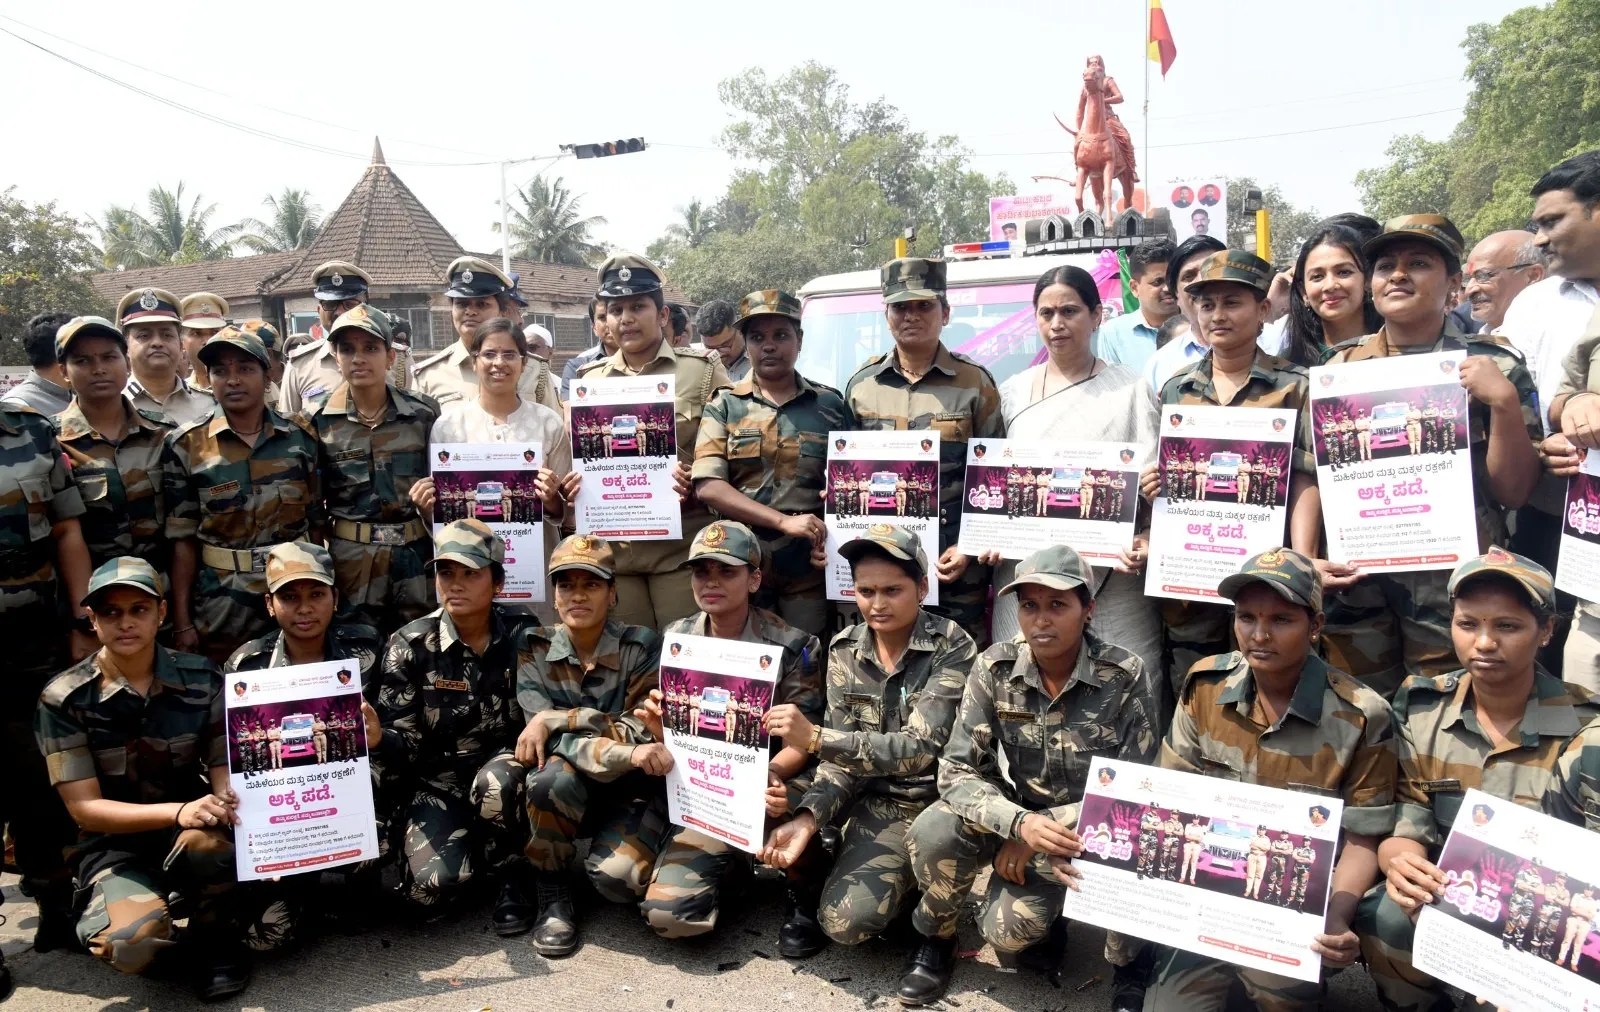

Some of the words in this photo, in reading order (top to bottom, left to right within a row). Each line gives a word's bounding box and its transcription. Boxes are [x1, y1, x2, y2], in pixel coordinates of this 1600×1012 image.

[1334, 471, 1373, 482] ಮಹಿಳೆಯರ
[1377, 468, 1396, 478] ಮತ್ತು
[1398, 465, 1422, 476] ಮಕ್ಕಳ
[1425, 460, 1453, 473] ರಕ್ಷಣೆಗೆ
[602, 476, 625, 491] ಅಕ್ಕ
[627, 474, 650, 486] ಪಡೆ.
[1358, 484, 1391, 505] ಅಕ್ಕ
[1393, 478, 1427, 496] ಪಡೆ.
[1188, 523, 1214, 542] ಅಕ್ಕ
[1218, 524, 1247, 539] ಪಡೆ.
[246, 779, 284, 790] ಮಹಿಳೆಯರ
[287, 776, 305, 786] ಮತ್ತು
[306, 771, 329, 784] ಮಕ್ಕಳ
[331, 768, 356, 779] ರಕ್ಷಣೆಗೆ
[688, 758, 708, 780] ಅಕ್ಕ
[710, 762, 734, 781] ಪಡೆ.
[269, 790, 300, 811] ಅಕ್ಕ
[302, 784, 335, 803] ಪಡೆ.
